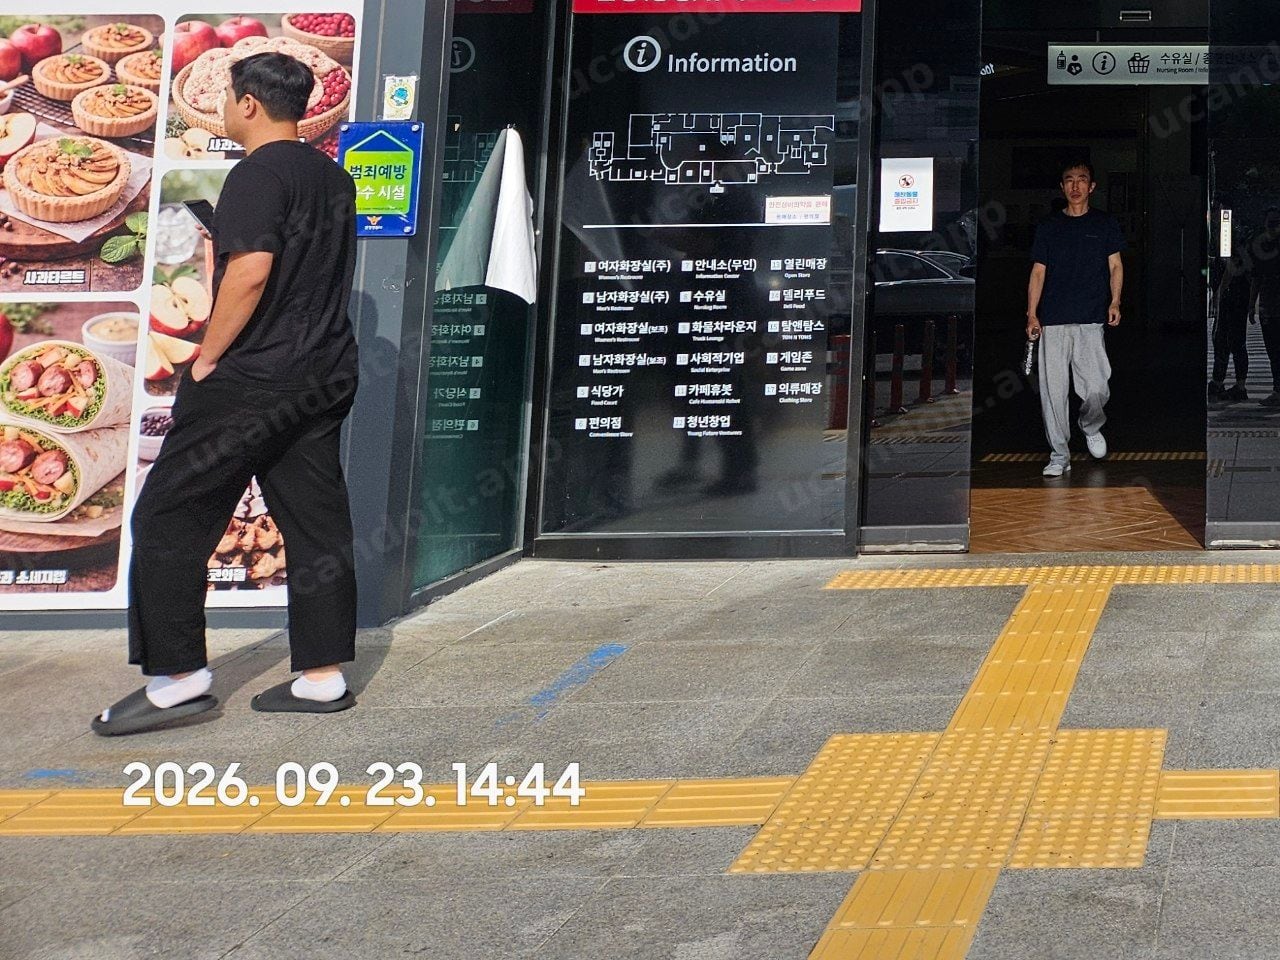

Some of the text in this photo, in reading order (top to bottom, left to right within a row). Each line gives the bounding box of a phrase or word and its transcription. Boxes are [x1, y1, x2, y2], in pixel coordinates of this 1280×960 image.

[668, 52, 797, 73] Information
[1159, 52, 1193, 65] 수유실
[350, 164, 407, 180] 범죄예방
[378, 184, 405, 200] 시설
[598, 260, 671, 273] 여자화장실(주)
[695, 258, 757, 272] 안내소(무인)
[784, 257, 828, 270] 열린매장
[24, 269, 86, 285] 사과타르트
[596, 290, 670, 304] 남자화장실(주)
[693, 290, 726, 303] 수유실
[783, 288, 826, 301] 델리푸드
[691, 320, 757, 334] 화물차라운지
[781, 319, 825, 332] 탐앤탐스
[690, 352, 745, 365] 사회적기업
[780, 351, 813, 364] 게임존
[591, 385, 625, 398] 식당가
[778, 382, 822, 395] 의류매장
[588, 416, 622, 429] 편의점
[687, 415, 731, 428] 청년창업
